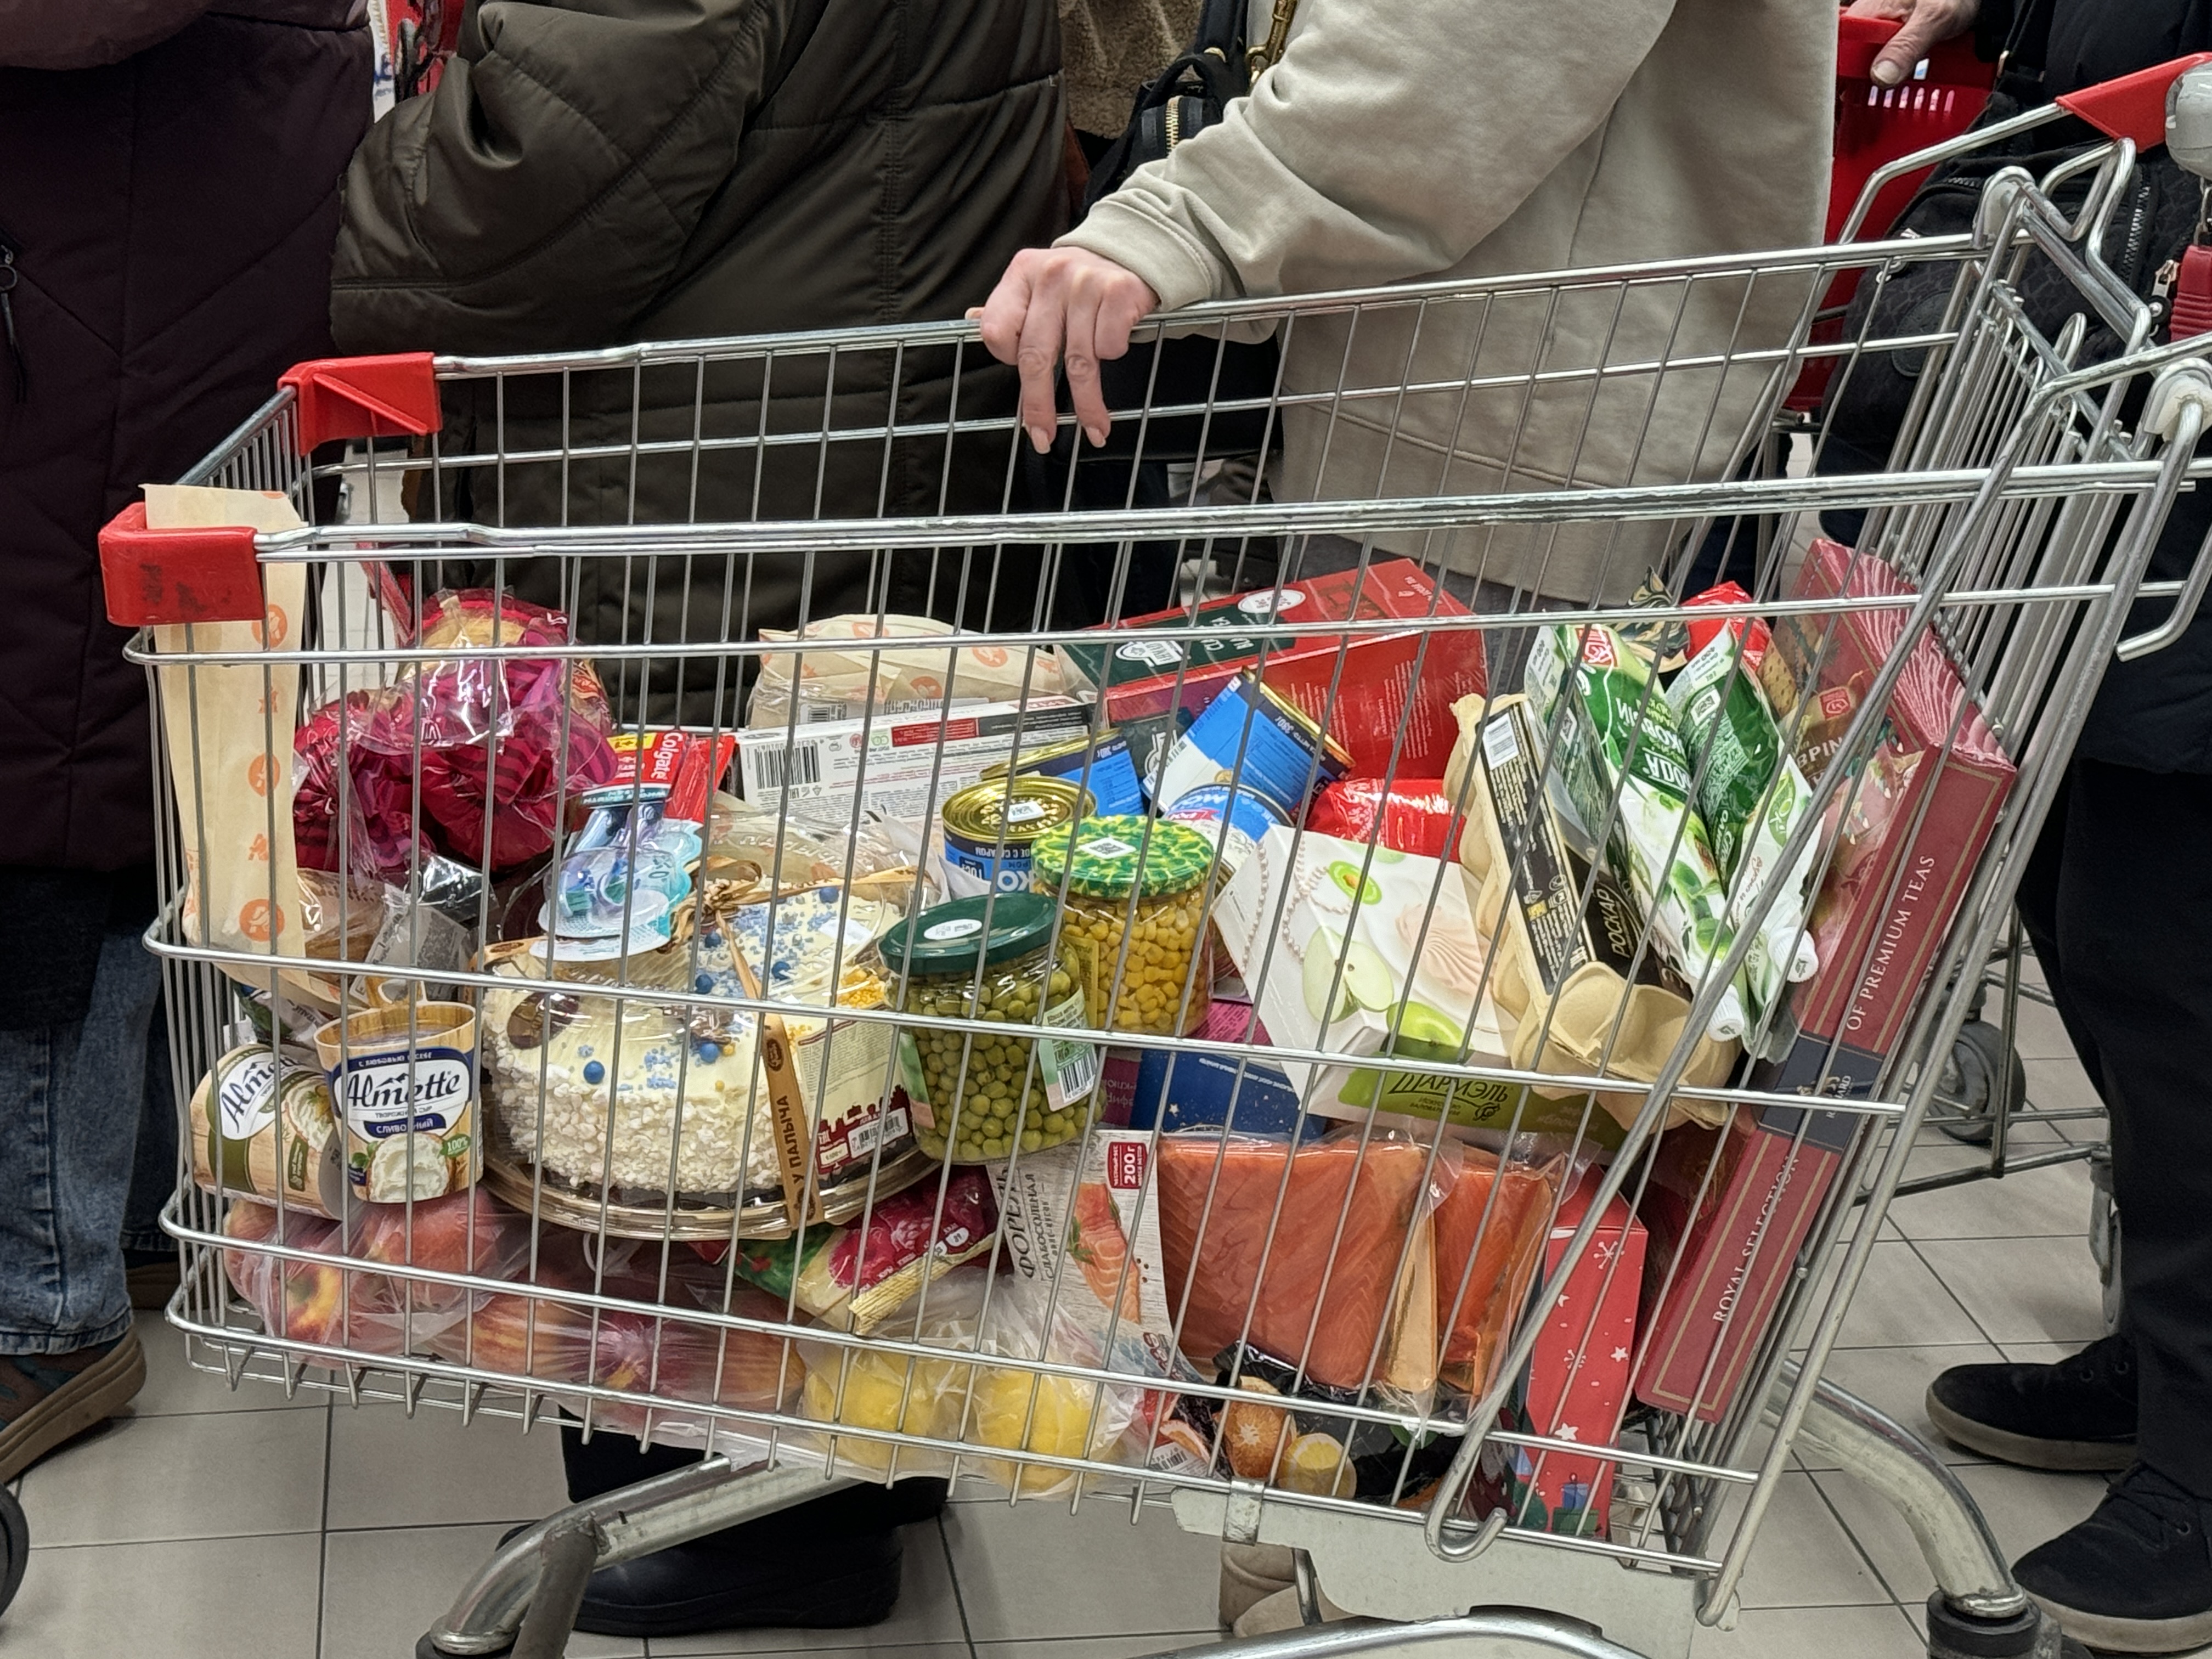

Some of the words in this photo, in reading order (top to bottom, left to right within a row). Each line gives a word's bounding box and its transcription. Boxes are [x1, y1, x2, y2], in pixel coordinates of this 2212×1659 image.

[651, 732, 684, 780] Colgate
[1607, 888, 1629, 958] РОСКАР
[1846, 1006, 1866, 1031] OF
[1861, 909, 1911, 1001] PREMIUM
[1902, 855, 1935, 902] TEAS
[345, 1070, 461, 1108] Almette
[376, 1117, 434, 1135] СЛИВОНЫЙ
[446, 1136, 468, 1153] 100%
[780, 1094, 802, 1169] ПАЛЫЧА
[793, 1173, 802, 1185] У
[1123, 1145, 1136, 1185] 200г
[1713, 1266, 1747, 1323] ROYAL
